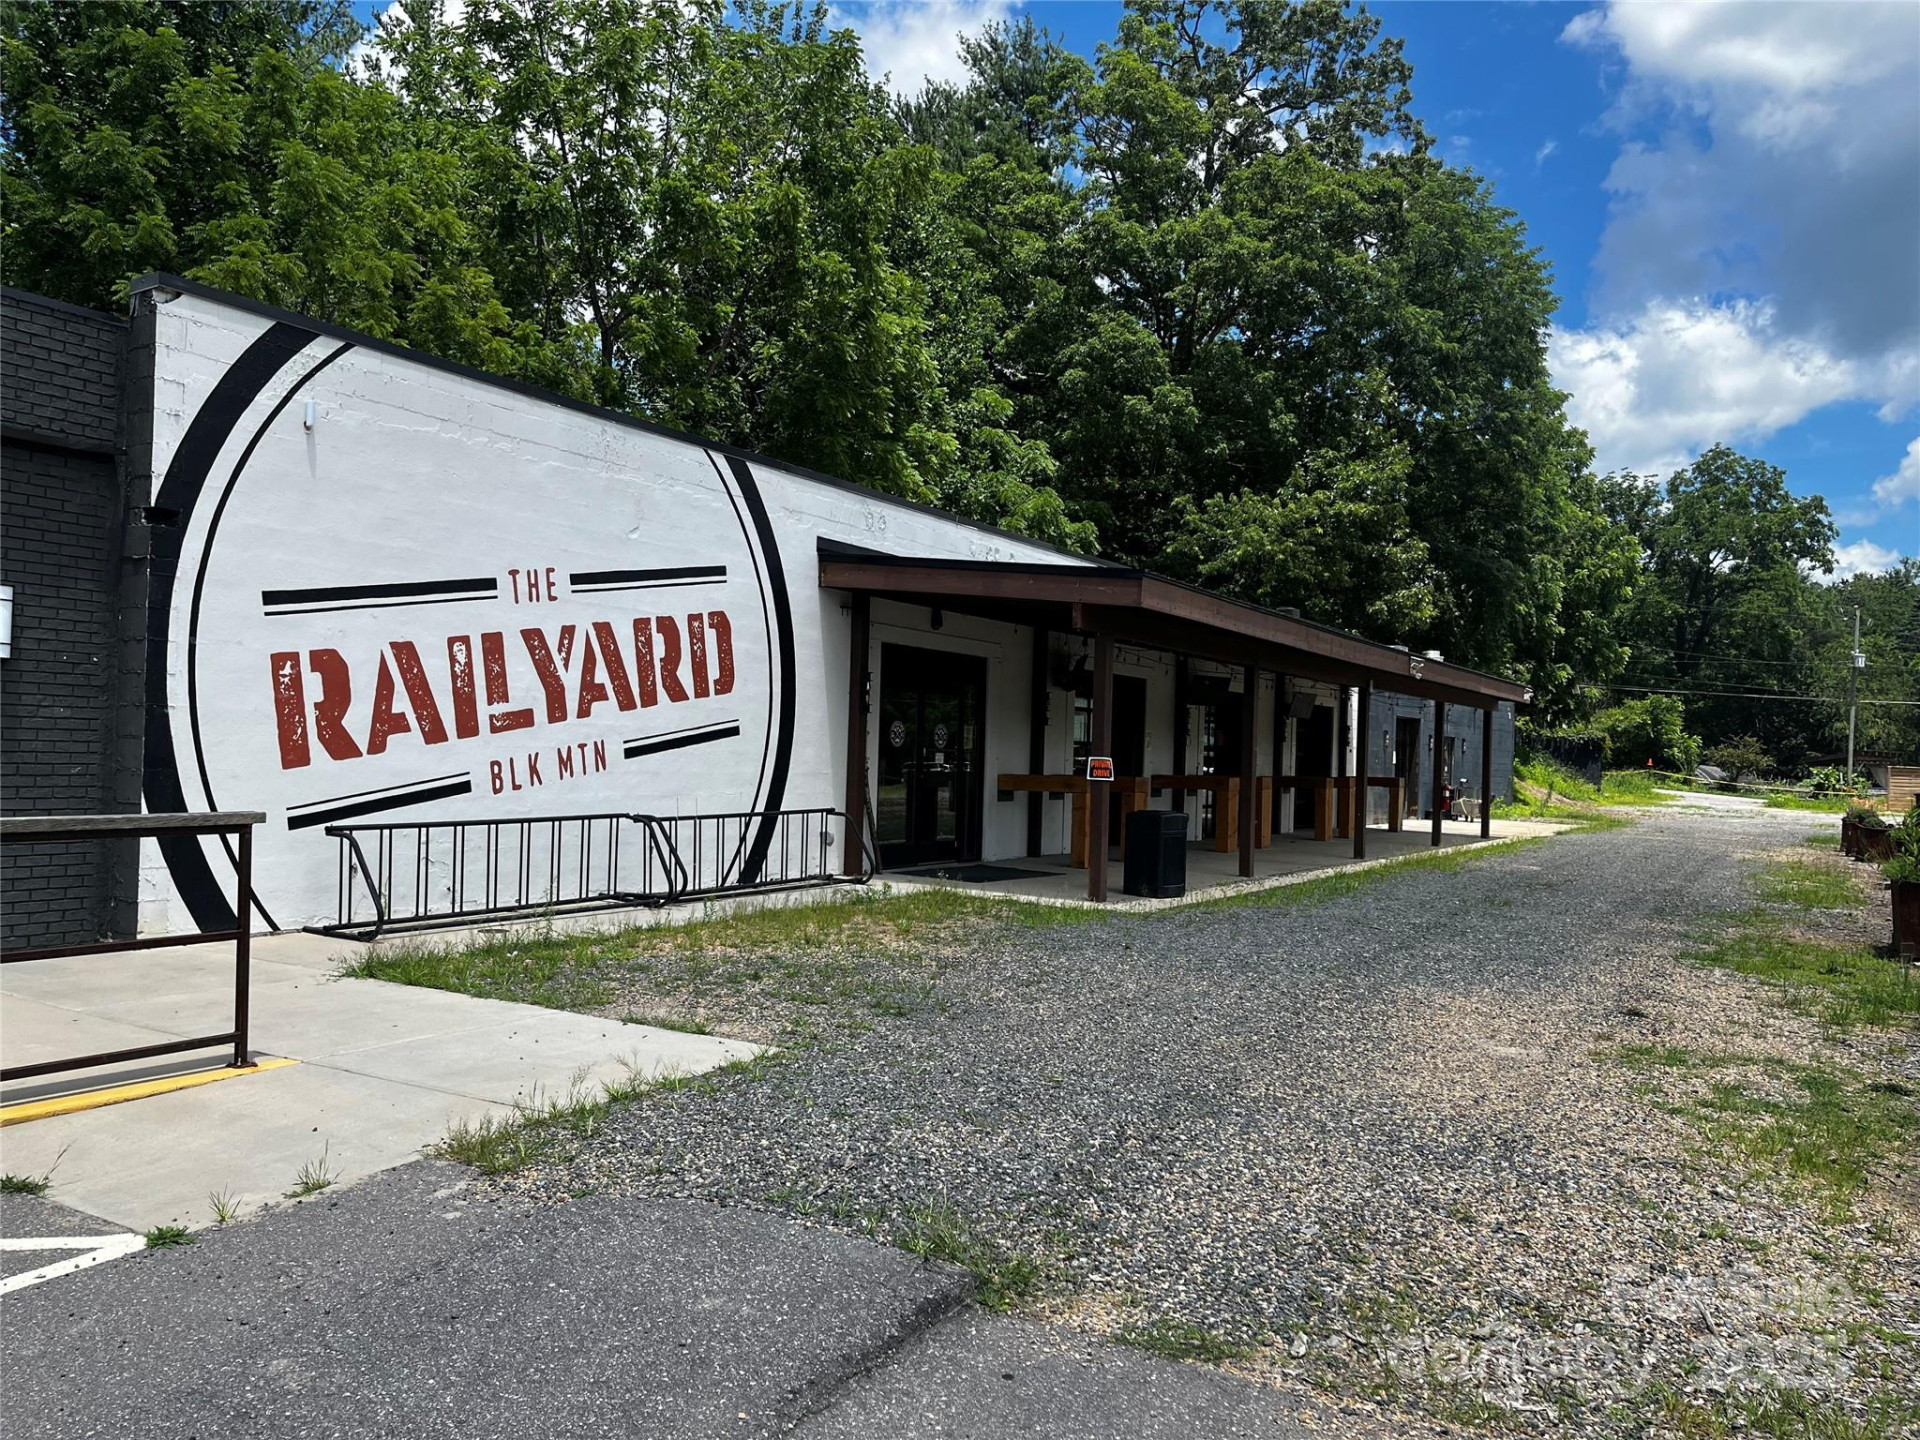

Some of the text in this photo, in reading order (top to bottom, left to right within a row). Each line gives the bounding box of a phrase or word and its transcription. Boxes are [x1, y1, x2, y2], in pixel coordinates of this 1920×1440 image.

[508, 567, 558, 604] THE
[269, 610, 736, 771] RAILYARD
[489, 739, 608, 796] BLK MTN
[1092, 769, 1111, 777] DRIVE
